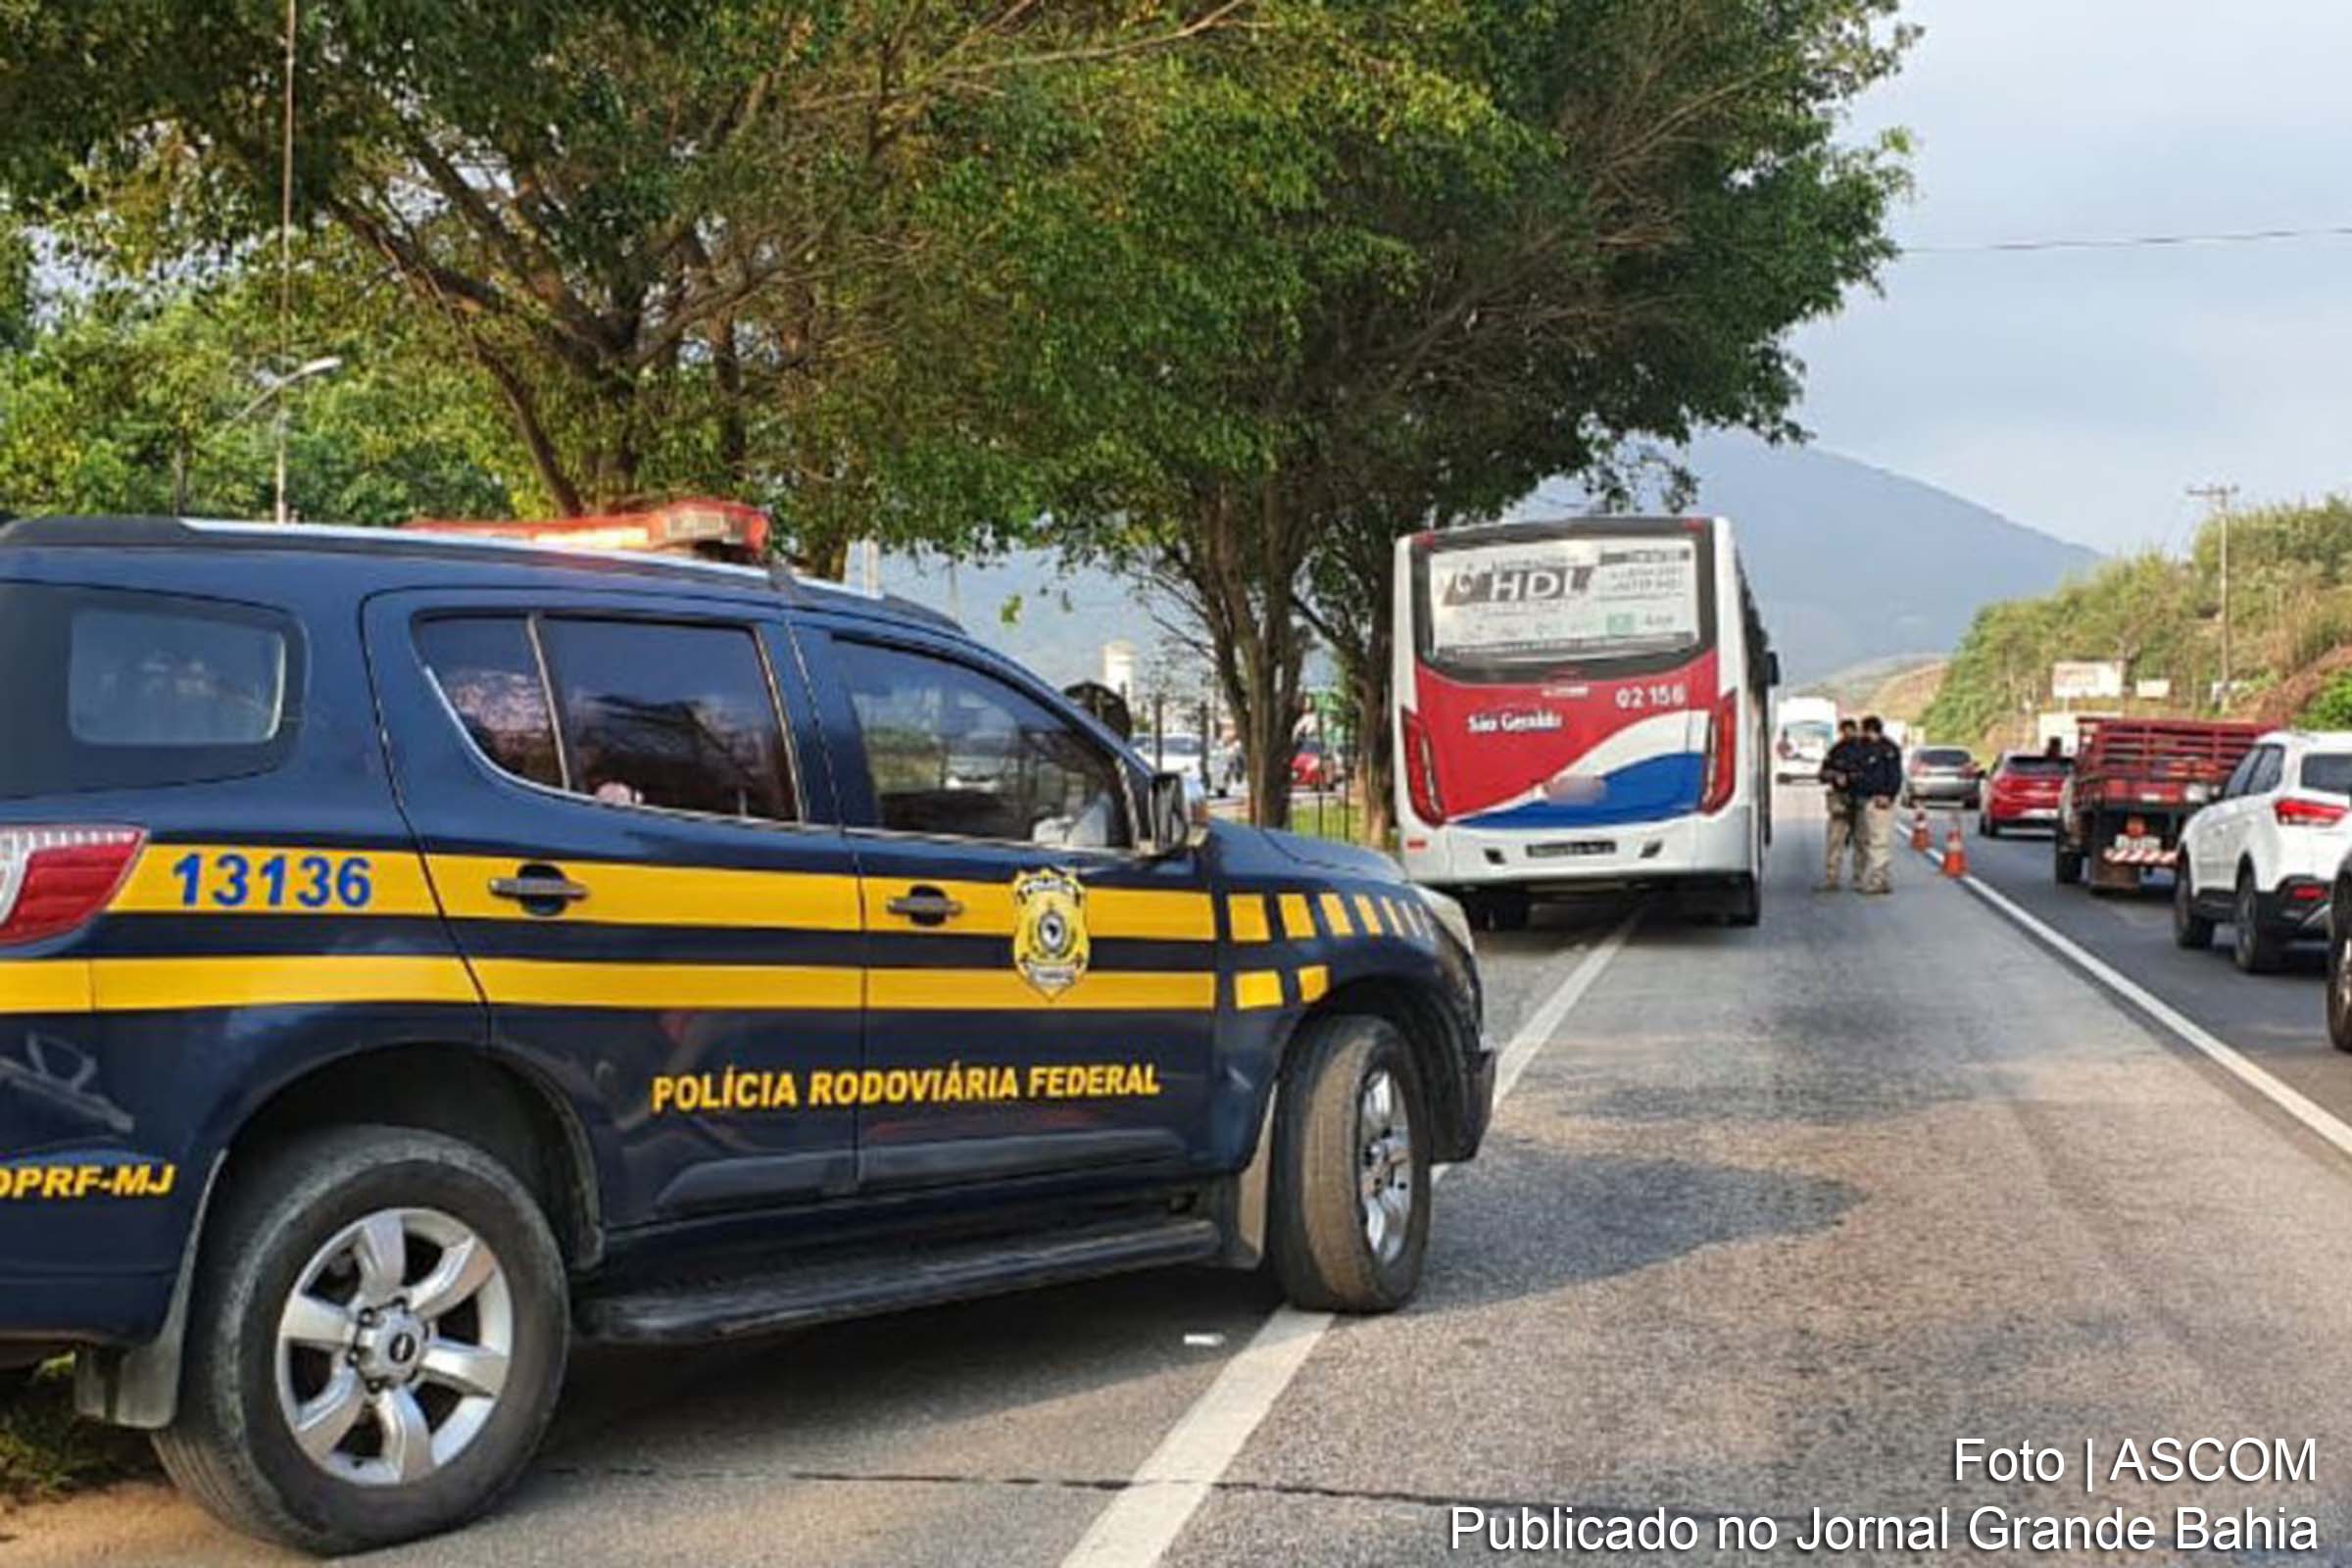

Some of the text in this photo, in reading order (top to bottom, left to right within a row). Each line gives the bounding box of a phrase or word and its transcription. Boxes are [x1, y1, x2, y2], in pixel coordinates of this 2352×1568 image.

[173, 853, 372, 907] 13136
[651, 1060, 1160, 1112] POLÍCIA RODOVIÁRIA FEDERAL
